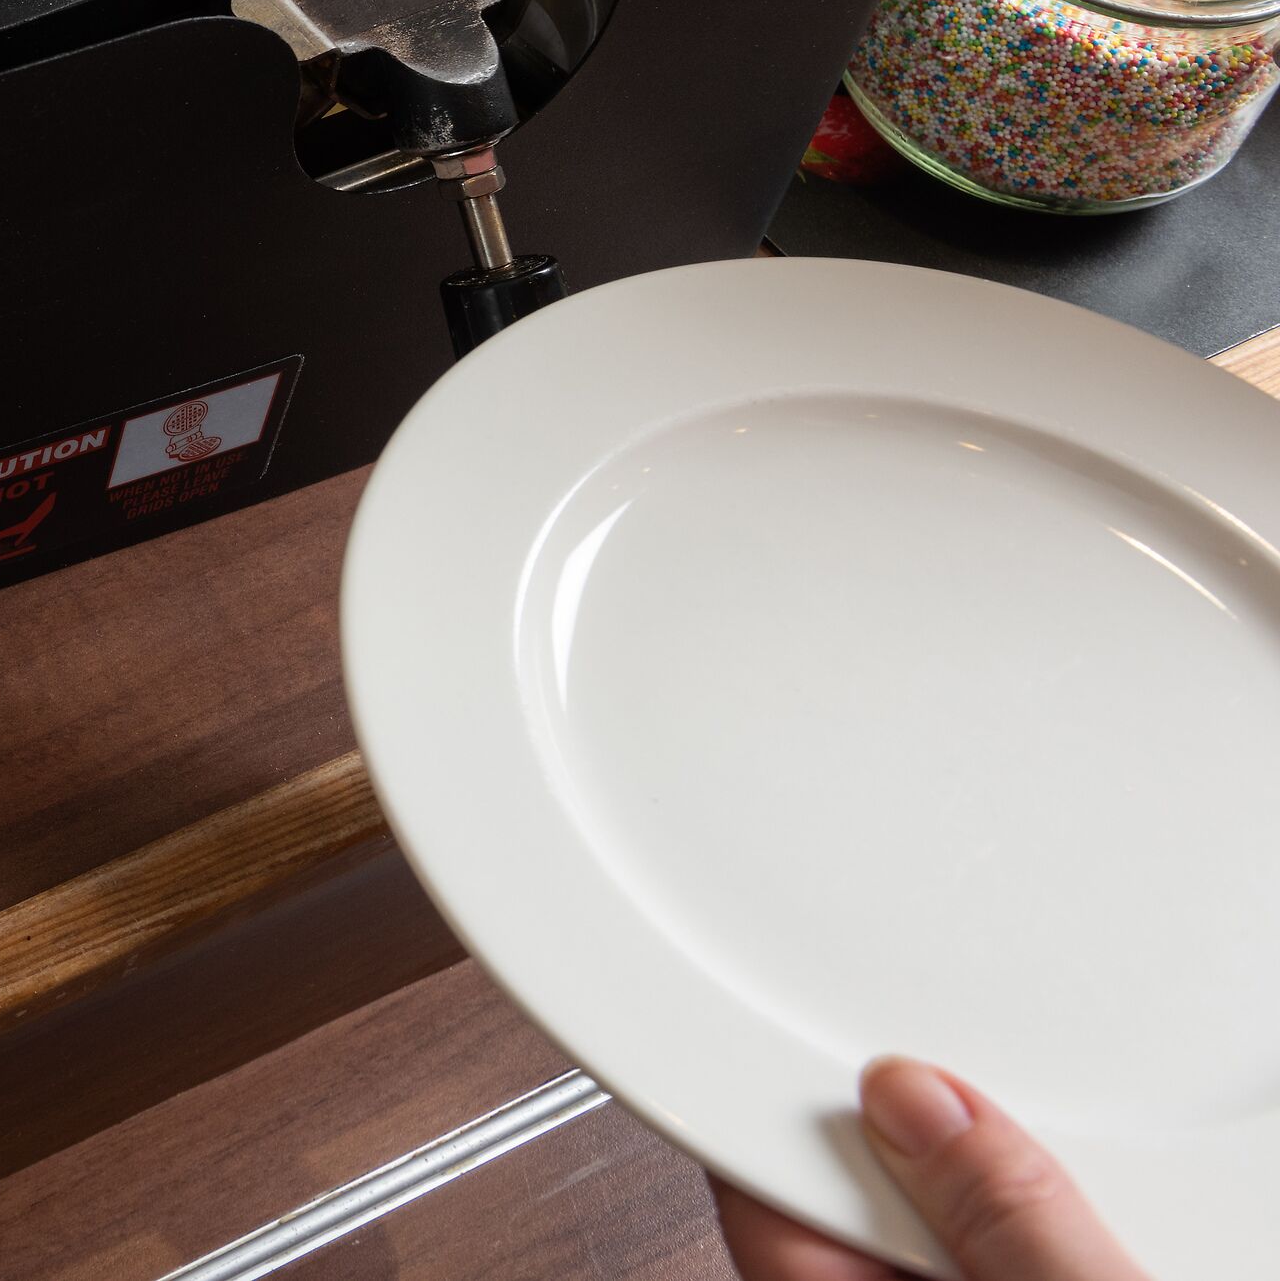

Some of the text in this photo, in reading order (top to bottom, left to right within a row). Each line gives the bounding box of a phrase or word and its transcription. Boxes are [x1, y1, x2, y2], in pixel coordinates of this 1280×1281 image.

[109, 480, 156, 503] WHEN
[158, 469, 192, 492] NOT
[123, 468, 231, 510] PLEASE LEAVE
[126, 482, 220, 521] GRIDS OPEN
